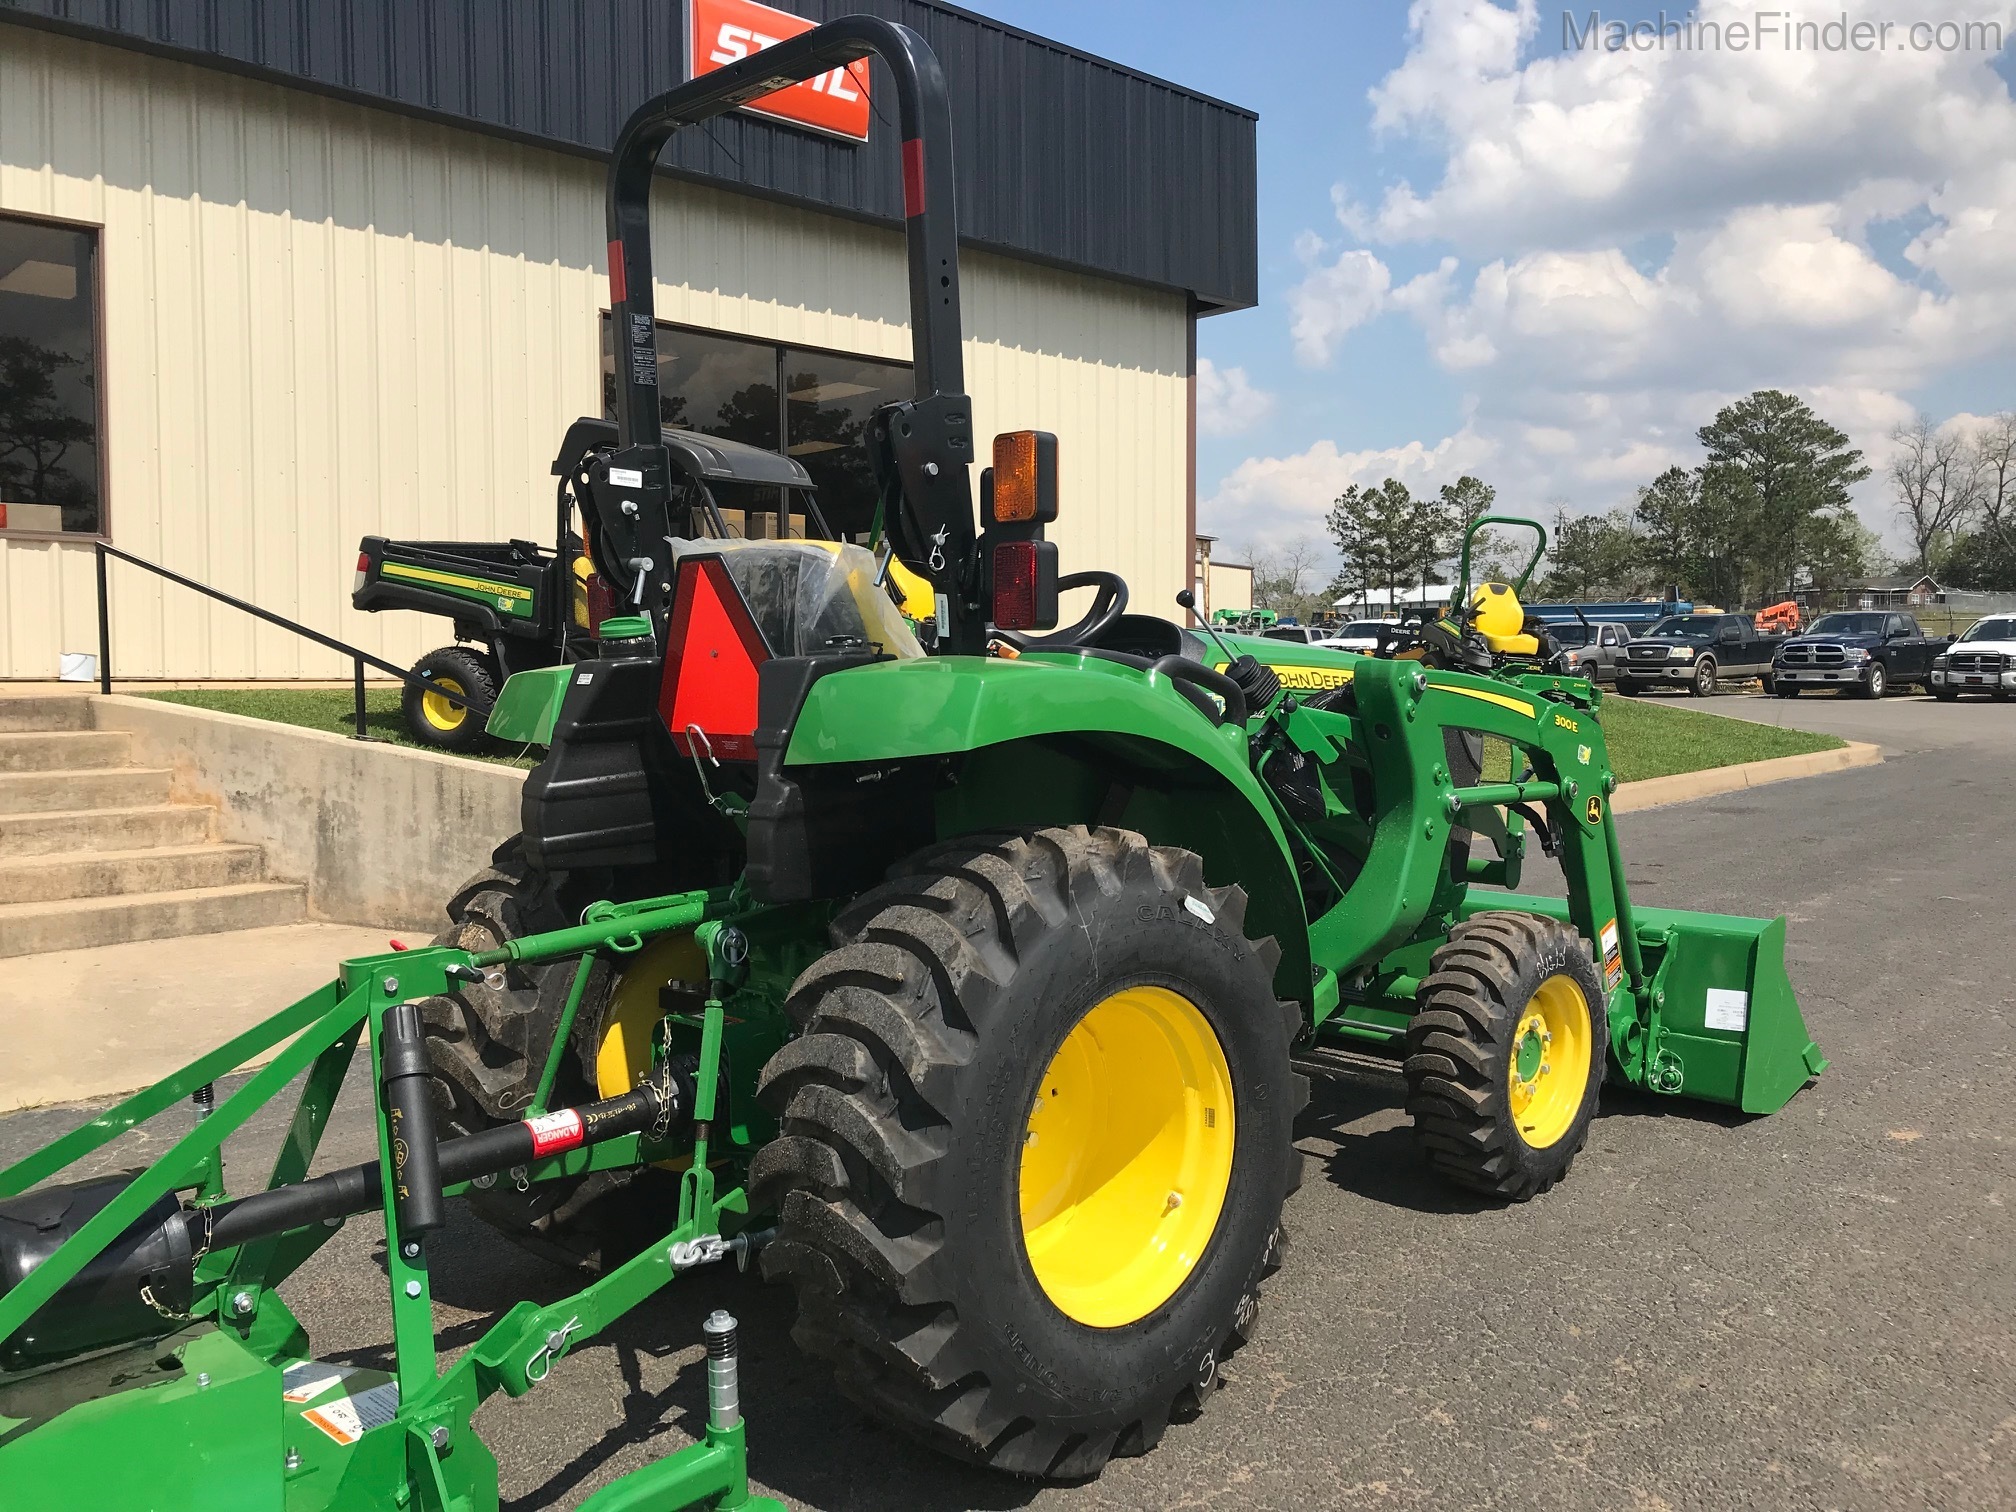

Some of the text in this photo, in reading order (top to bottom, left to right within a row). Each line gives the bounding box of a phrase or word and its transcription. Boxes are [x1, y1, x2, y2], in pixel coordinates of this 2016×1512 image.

[474, 582, 523, 598] JOHN DEERE
[1277, 671, 1353, 688] OHN DEER
[1554, 714, 1579, 733] 300E
[537, 1127, 570, 1144] DANGER
